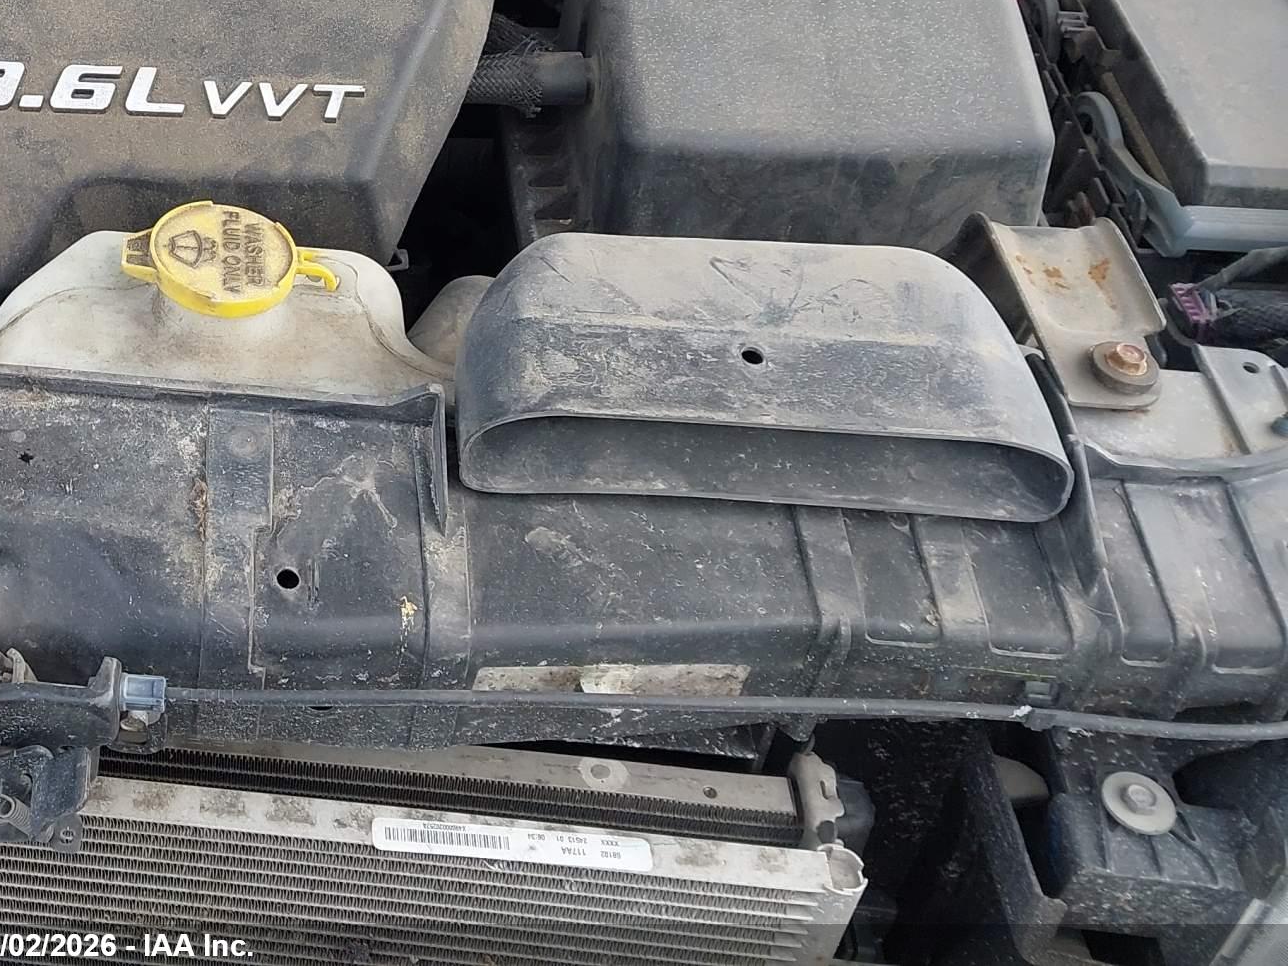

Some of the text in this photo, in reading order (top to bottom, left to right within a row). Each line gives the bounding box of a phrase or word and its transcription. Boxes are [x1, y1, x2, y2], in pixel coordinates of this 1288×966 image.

[202, 79, 367, 123] VVT
[222, 210, 242, 294] FLUID ONLY
[244, 223, 264, 286] WASHER
[561, 846, 587, 856] 117AA
